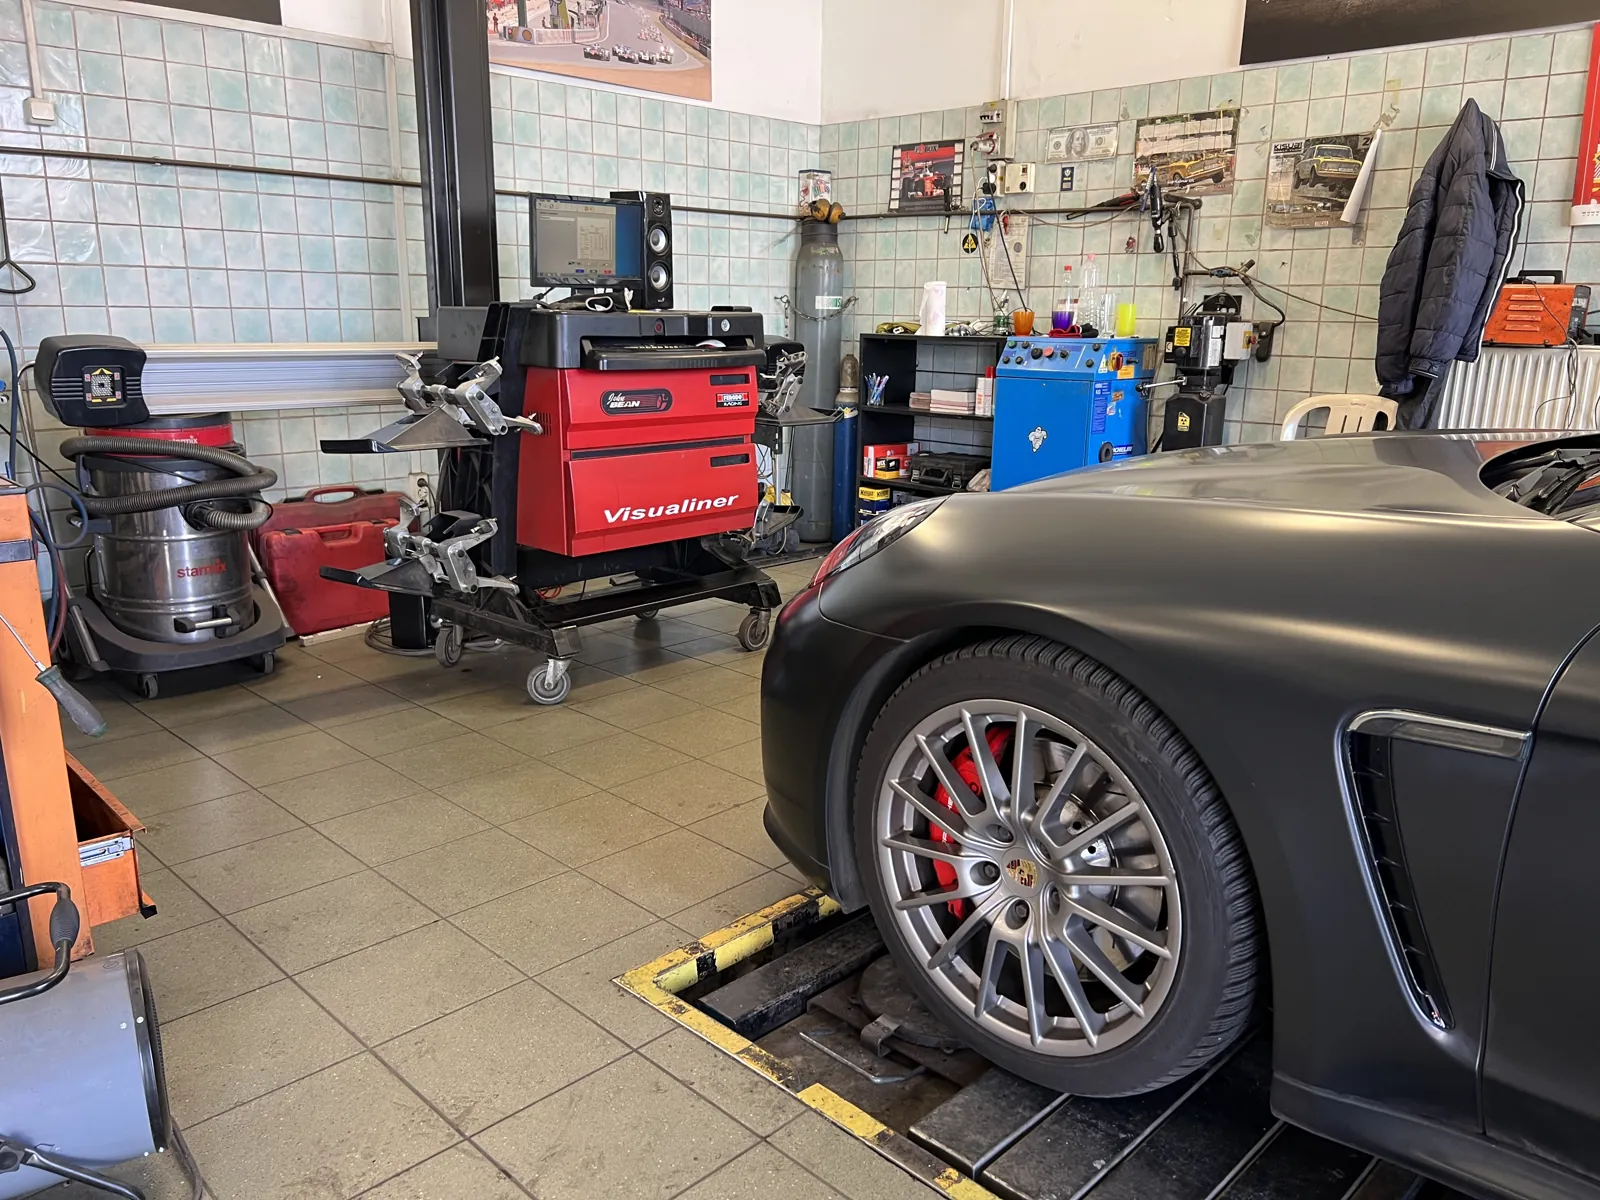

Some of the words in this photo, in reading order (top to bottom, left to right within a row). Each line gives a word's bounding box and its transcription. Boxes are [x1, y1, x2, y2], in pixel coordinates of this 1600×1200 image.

[607, 392, 625, 405] John
[610, 400, 640, 408] BEAN
[604, 494, 739, 523] Visualiner
